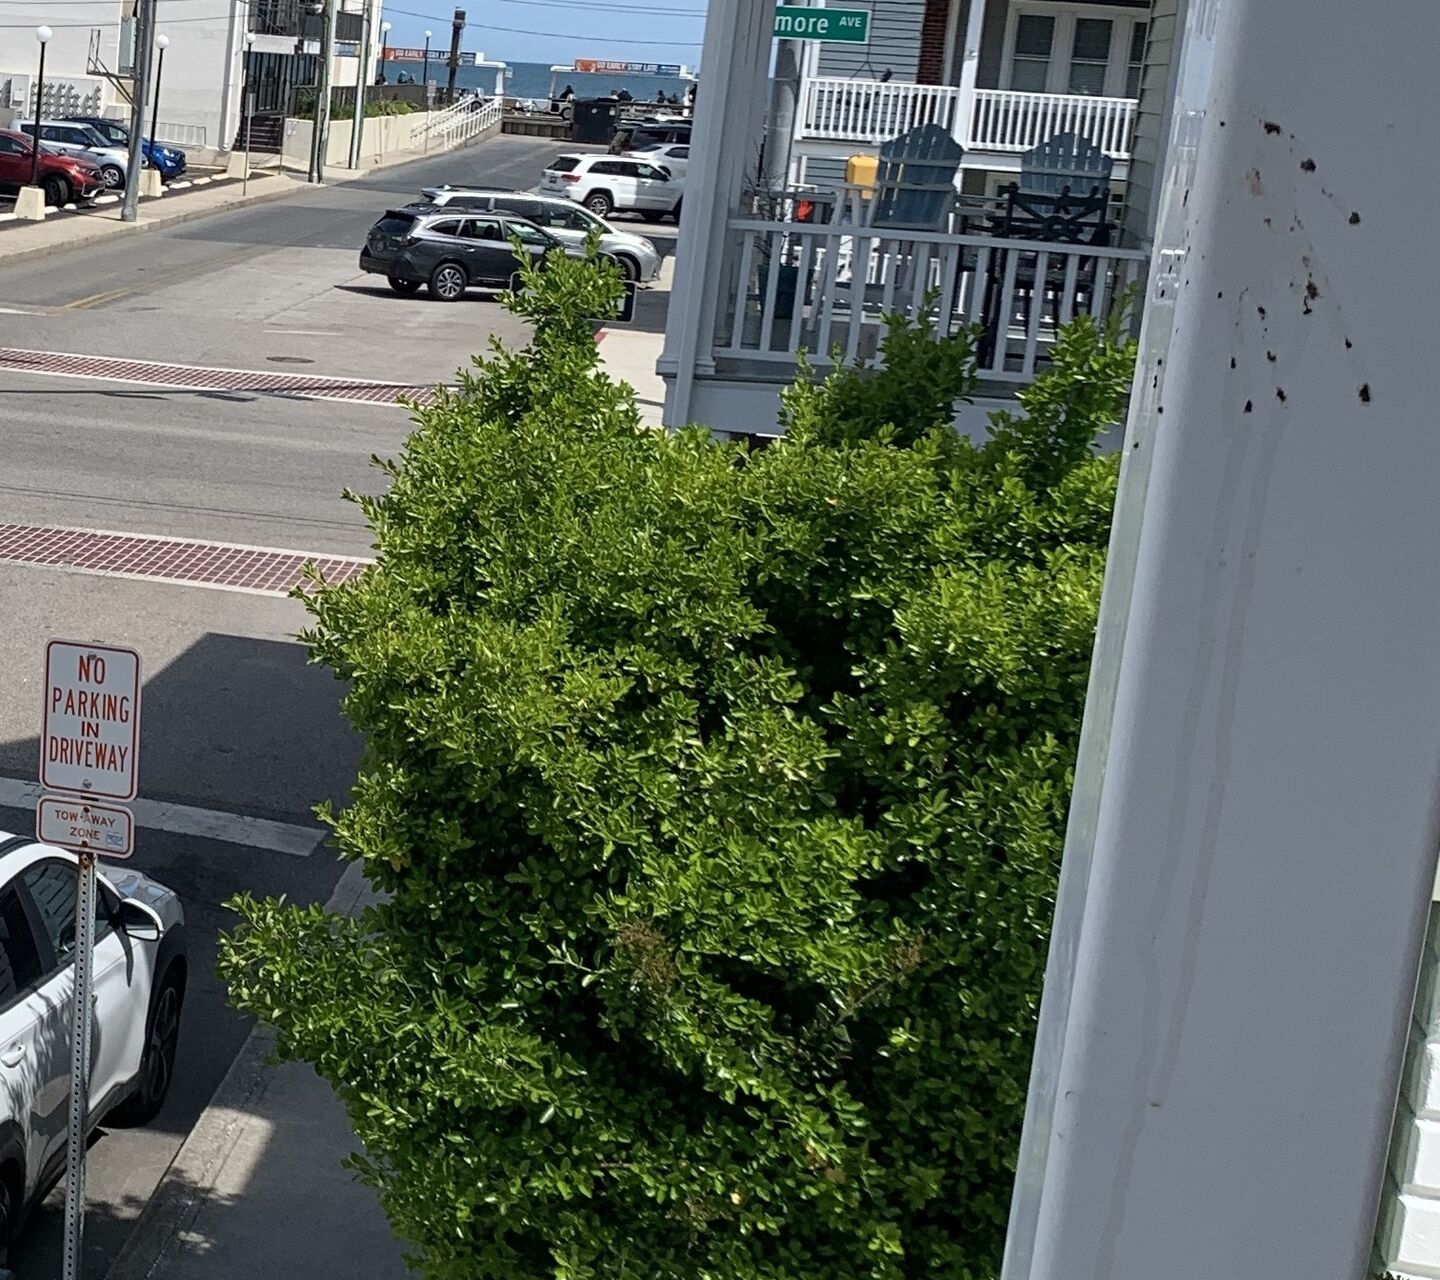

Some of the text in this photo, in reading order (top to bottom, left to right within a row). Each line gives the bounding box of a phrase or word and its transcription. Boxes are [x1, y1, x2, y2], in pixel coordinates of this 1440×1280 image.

[839, 16, 862, 28] AVE
[606, 61, 626, 71] EARLY
[626, 62, 643, 71] STAY
[643, 64, 659, 73] LATE
[78, 655, 106, 685] NO
[52, 687, 130, 723] PARKING
[81, 720, 100, 738] IN
[49, 736, 129, 772] DRIVEWAY
[69, 826, 101, 841] ZONE
